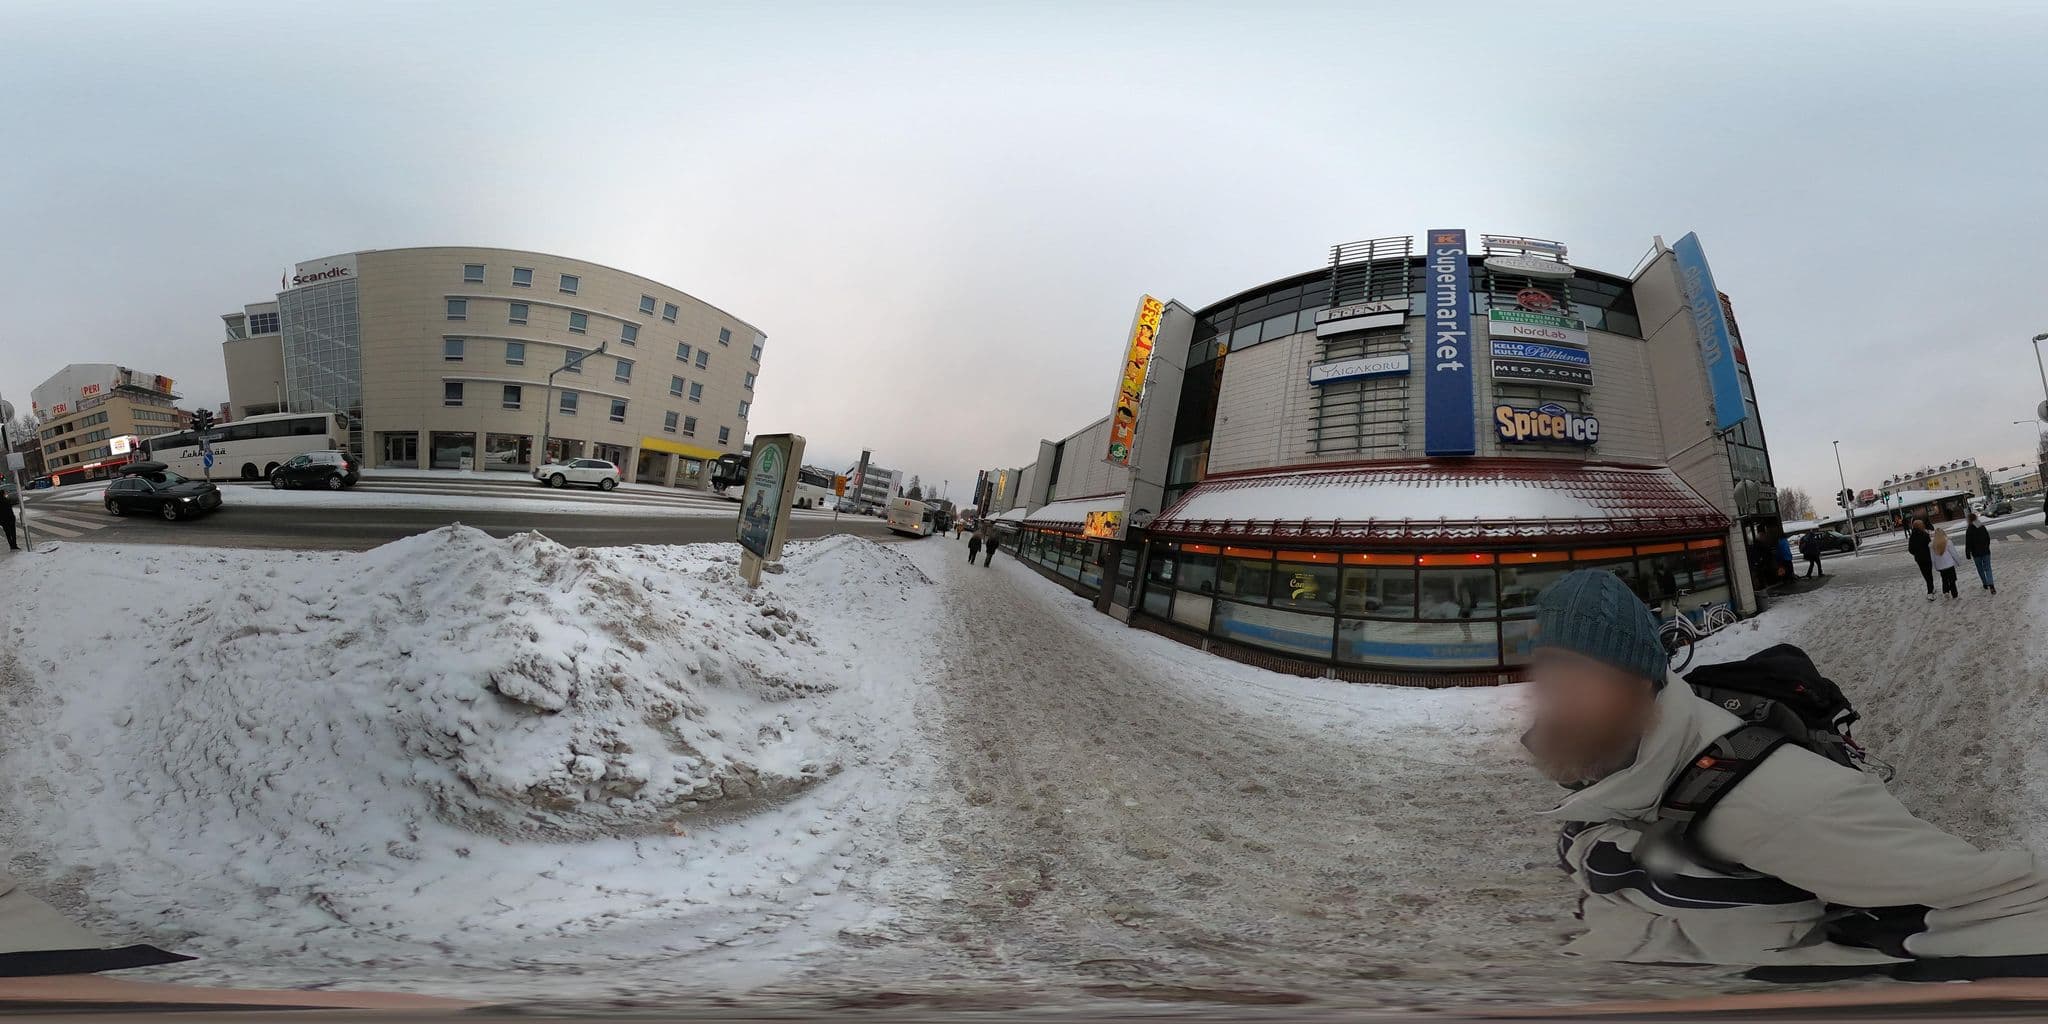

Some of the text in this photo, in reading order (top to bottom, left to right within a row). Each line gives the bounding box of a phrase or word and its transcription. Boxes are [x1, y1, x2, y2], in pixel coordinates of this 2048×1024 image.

[293, 267, 348, 285] Scandic
[1430, 248, 1467, 371] Supermarket
[1513, 326, 1567, 339] NordLab
[1494, 349, 1525, 357] KULTA
[1495, 365, 1592, 379] MEGAZONE
[83, 383, 100, 395] PERI
[52, 402, 67, 414] PERI
